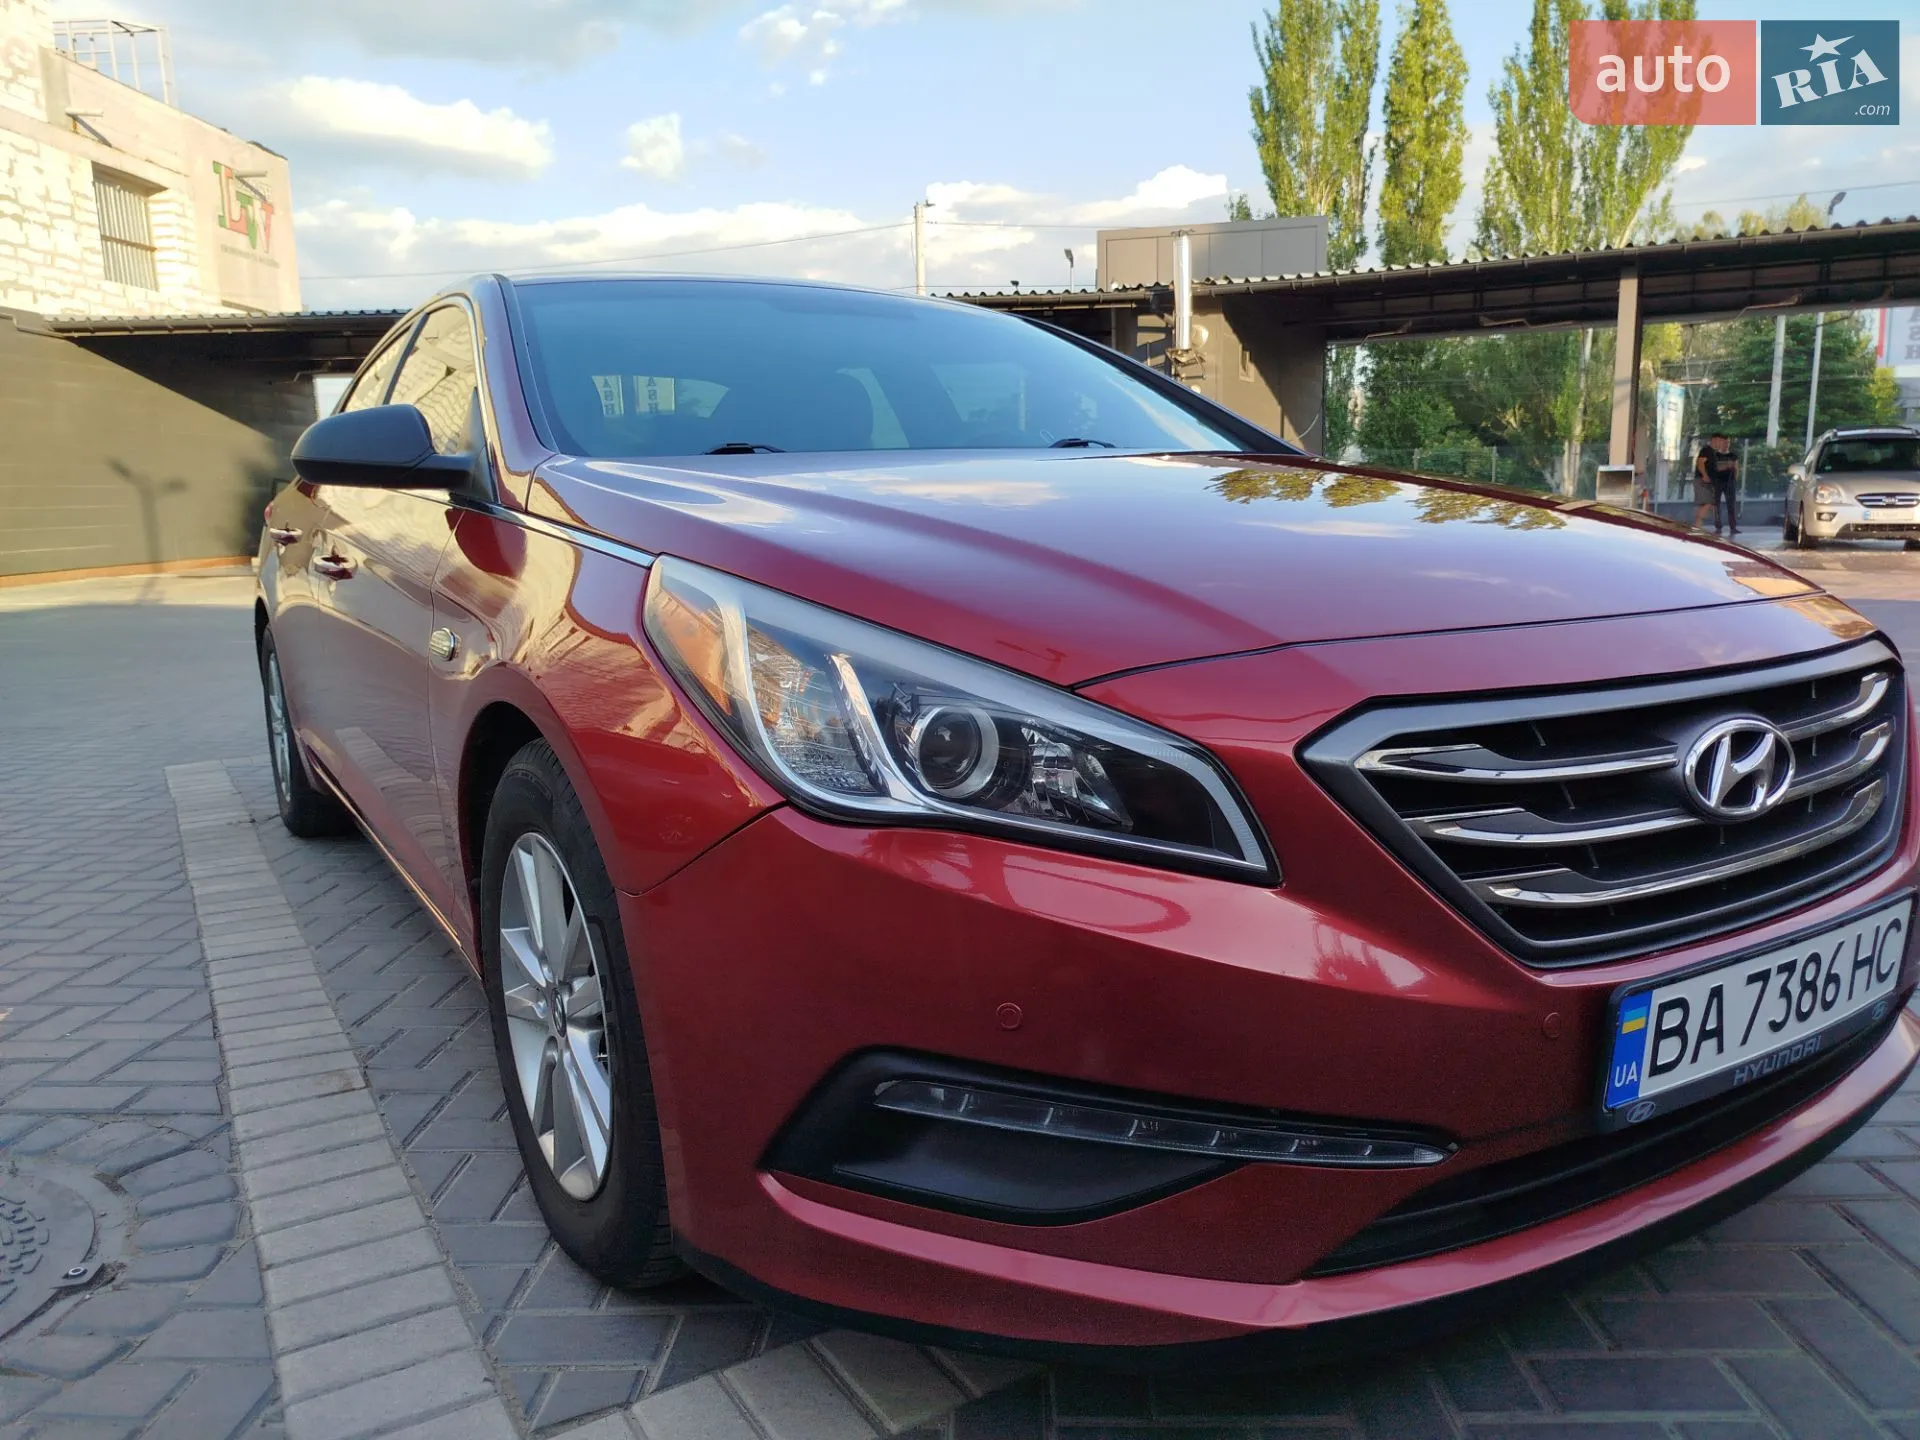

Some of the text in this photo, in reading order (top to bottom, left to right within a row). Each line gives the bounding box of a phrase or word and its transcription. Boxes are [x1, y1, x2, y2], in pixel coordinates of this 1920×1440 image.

[1648, 917, 1902, 1078] BA 7386 HC
[1614, 1061, 1638, 1088] UA
[1732, 1034, 1823, 1087] HYUNDAI
